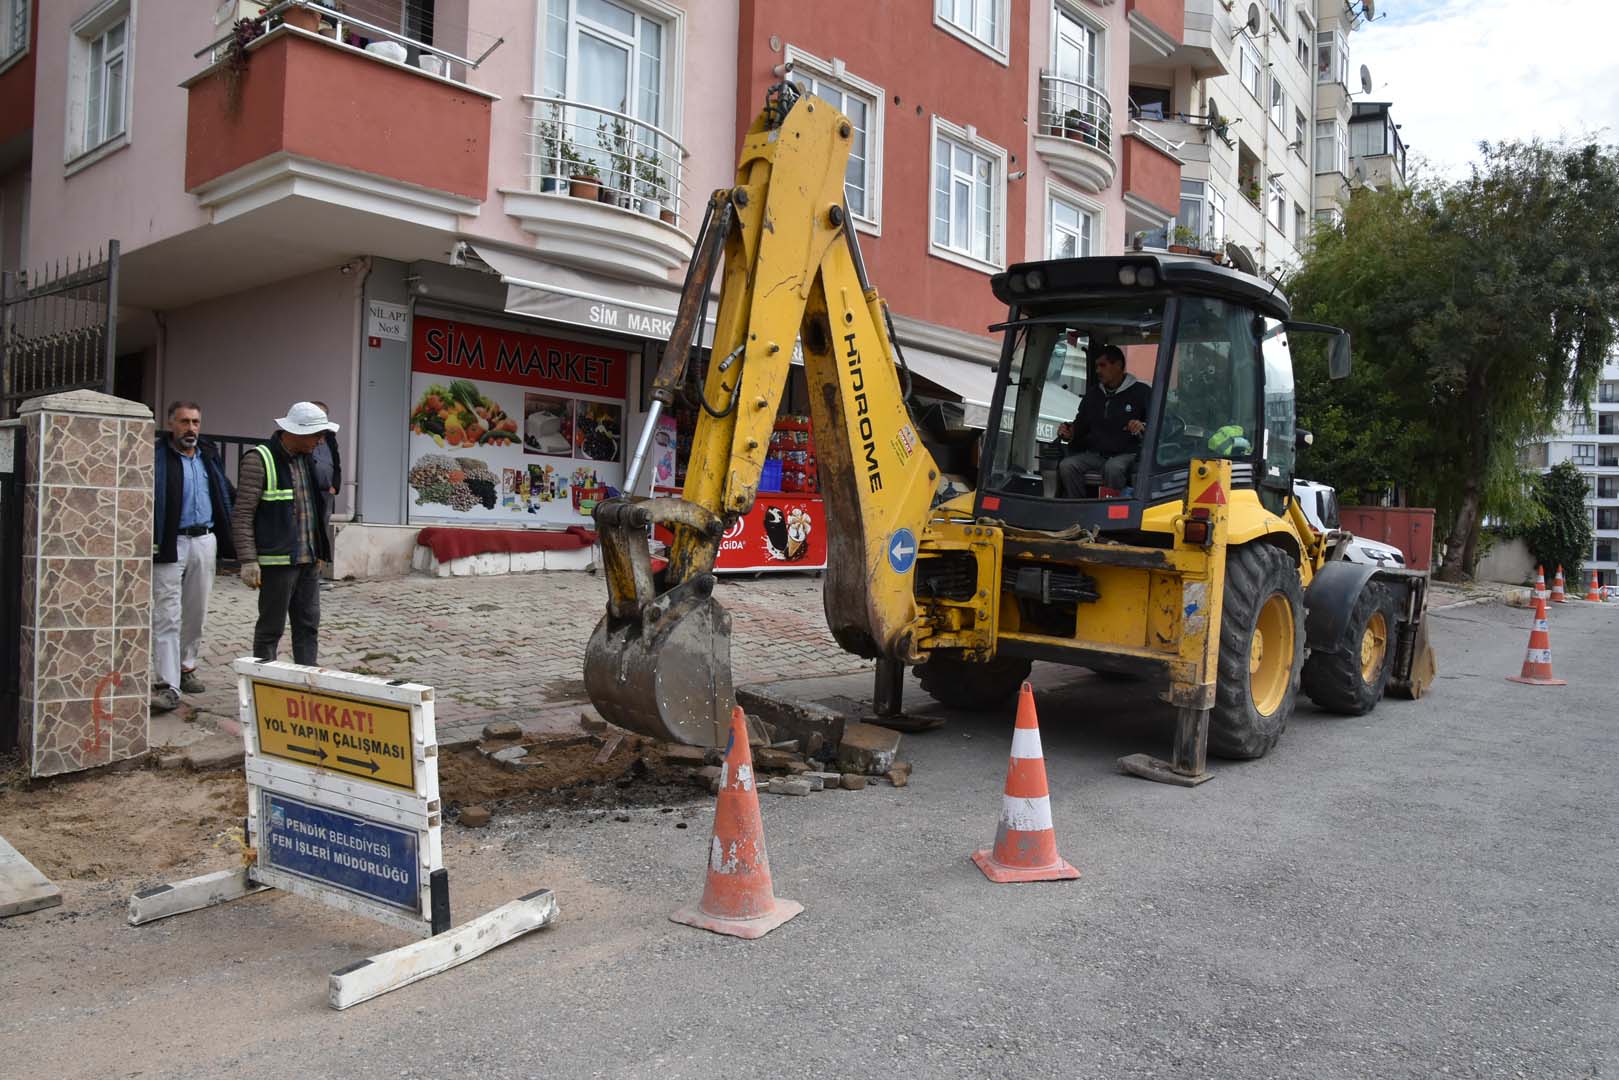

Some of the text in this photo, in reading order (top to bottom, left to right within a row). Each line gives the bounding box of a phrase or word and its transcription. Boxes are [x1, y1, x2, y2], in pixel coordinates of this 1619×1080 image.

[589, 304, 676, 336] SİM MARK
[425, 324, 614, 387] SİM MARKET
[286, 695, 375, 735] DİKKAT!
[264, 717, 405, 761] YOL YAPIM ÇALIŞMASI
[272, 833, 409, 884] FEN İŞLERİ MÜDÜRLÜĞÜ
[286, 817, 391, 859] PENDİK BELEDİYESİ
